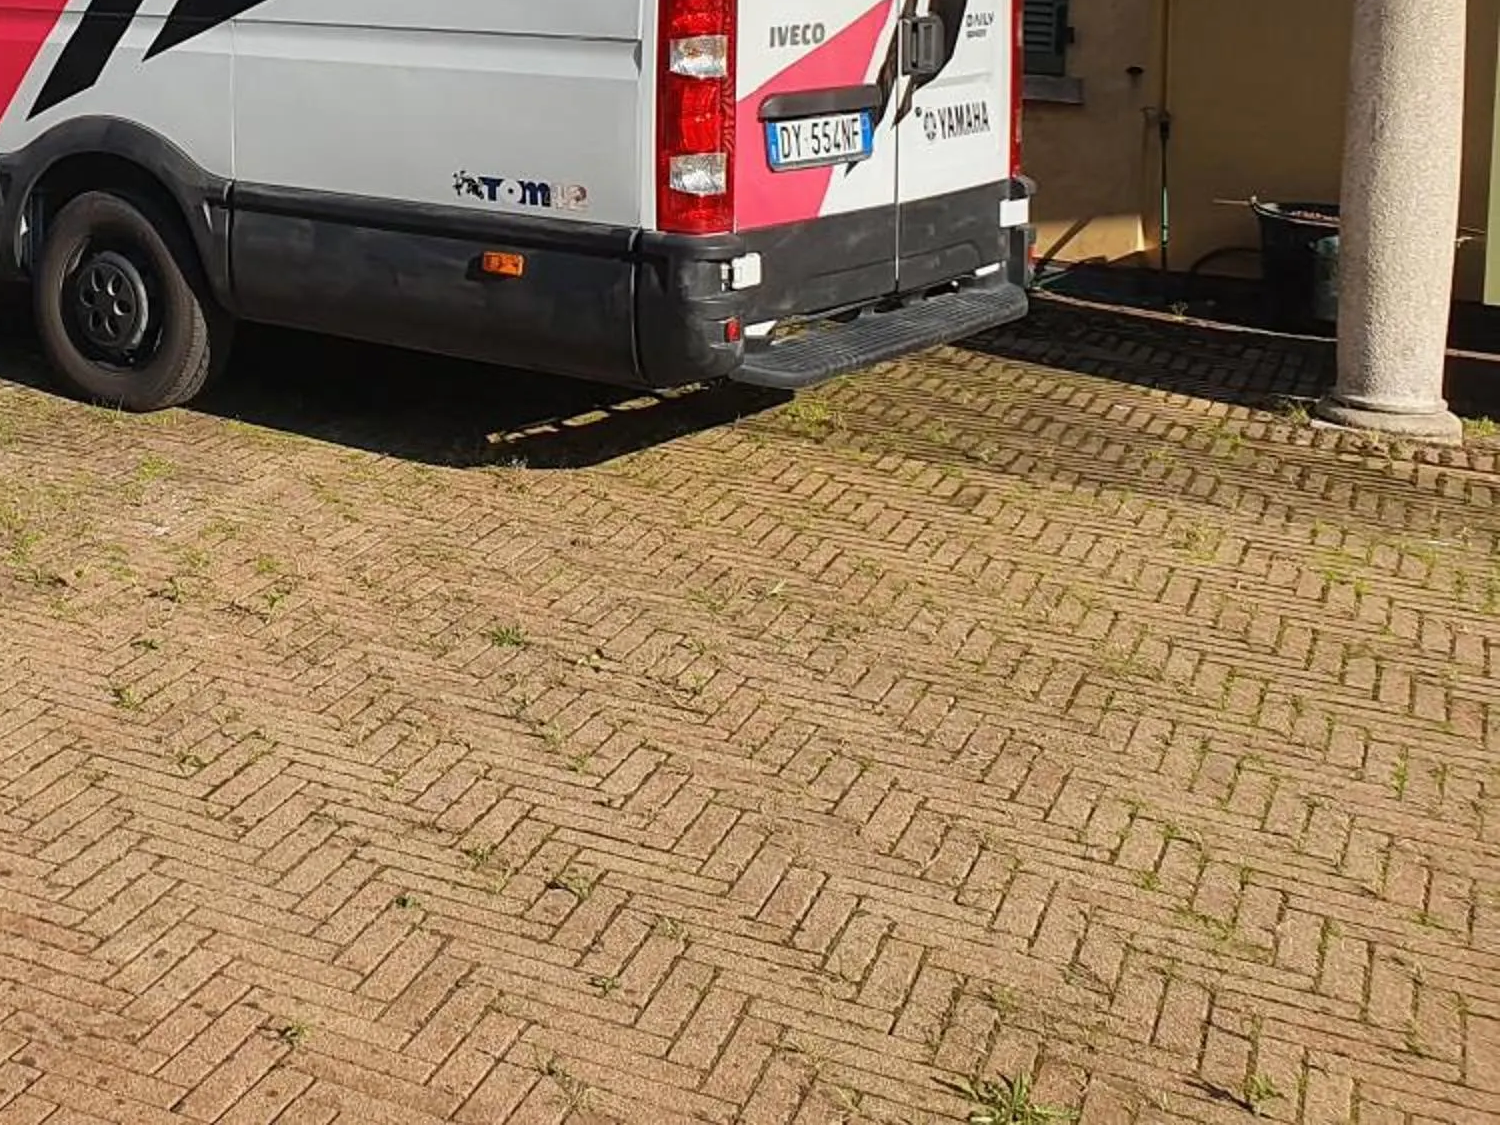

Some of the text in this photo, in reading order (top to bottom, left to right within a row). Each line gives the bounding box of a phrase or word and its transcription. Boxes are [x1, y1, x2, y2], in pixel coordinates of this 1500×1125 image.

[769, 22, 825, 48] IVECO
[937, 100, 991, 140] YAMAHA
[780, 124, 801, 159] DY
